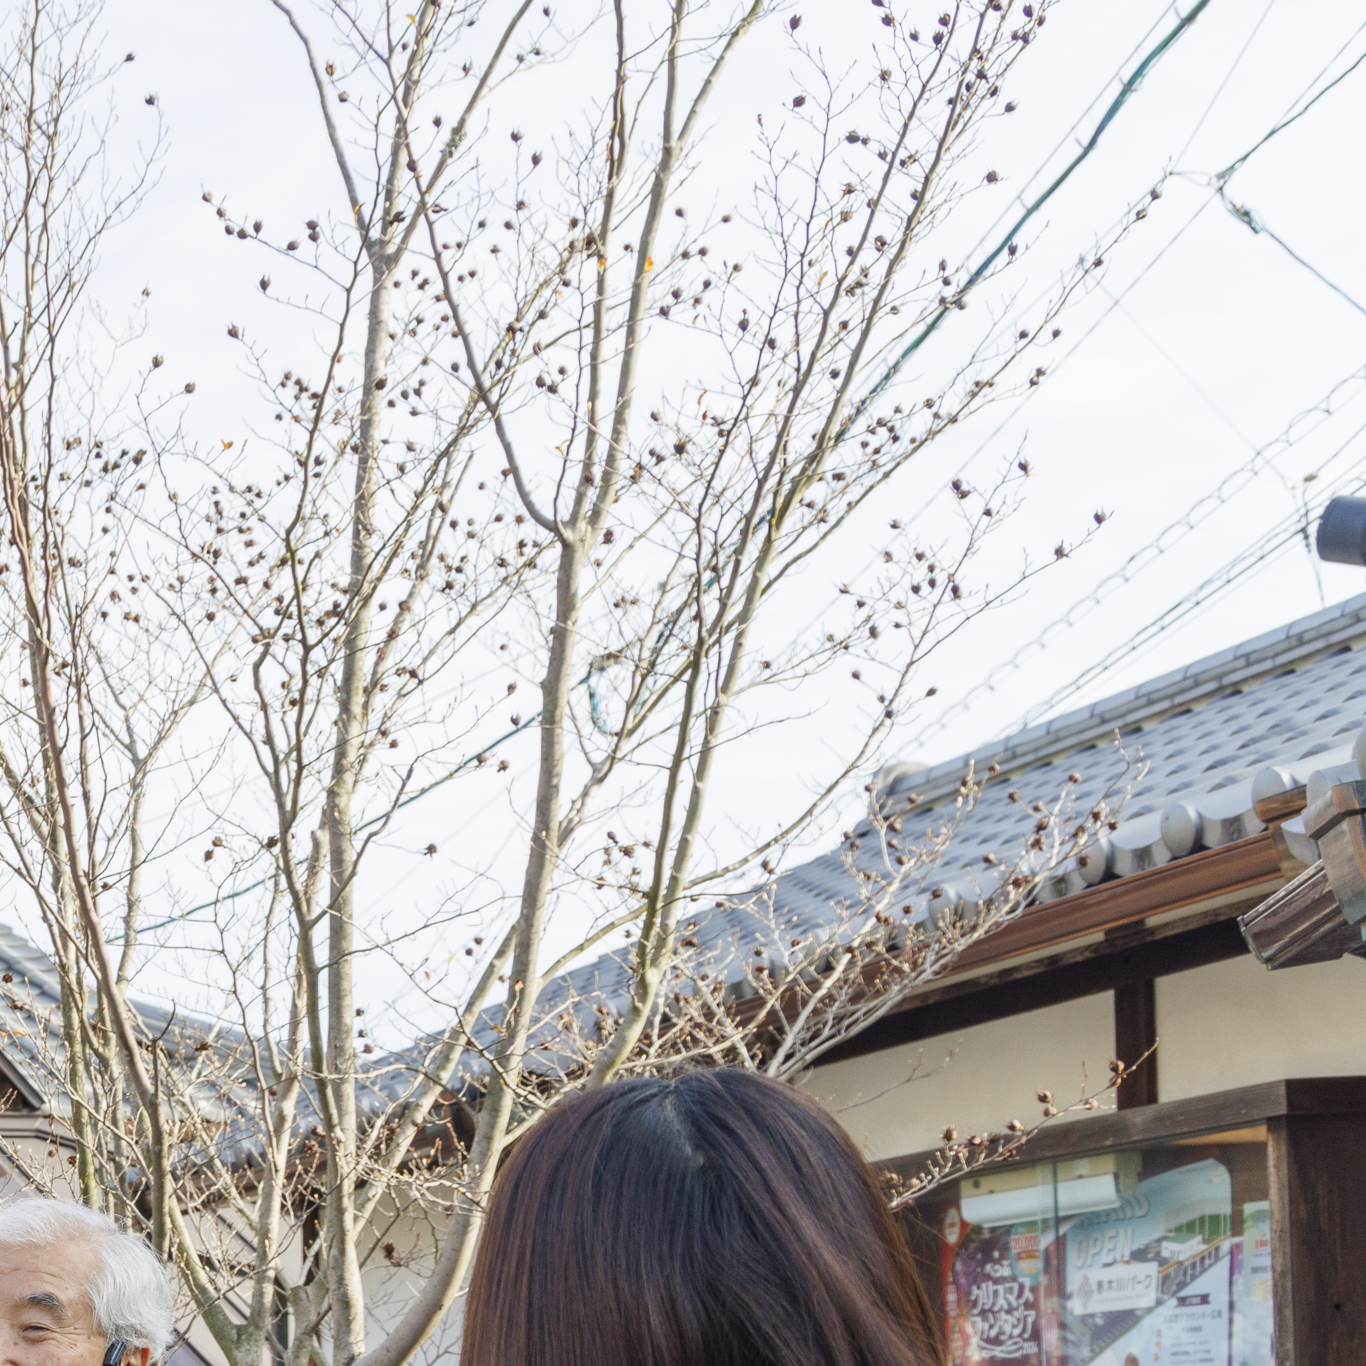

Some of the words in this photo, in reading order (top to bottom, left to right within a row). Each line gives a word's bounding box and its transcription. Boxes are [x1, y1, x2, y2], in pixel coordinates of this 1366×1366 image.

[1075, 1227, 1134, 1268] OPEN
[970, 1277, 1034, 1315] クリスマス
[970, 1304, 1036, 1341] ファンタジア
